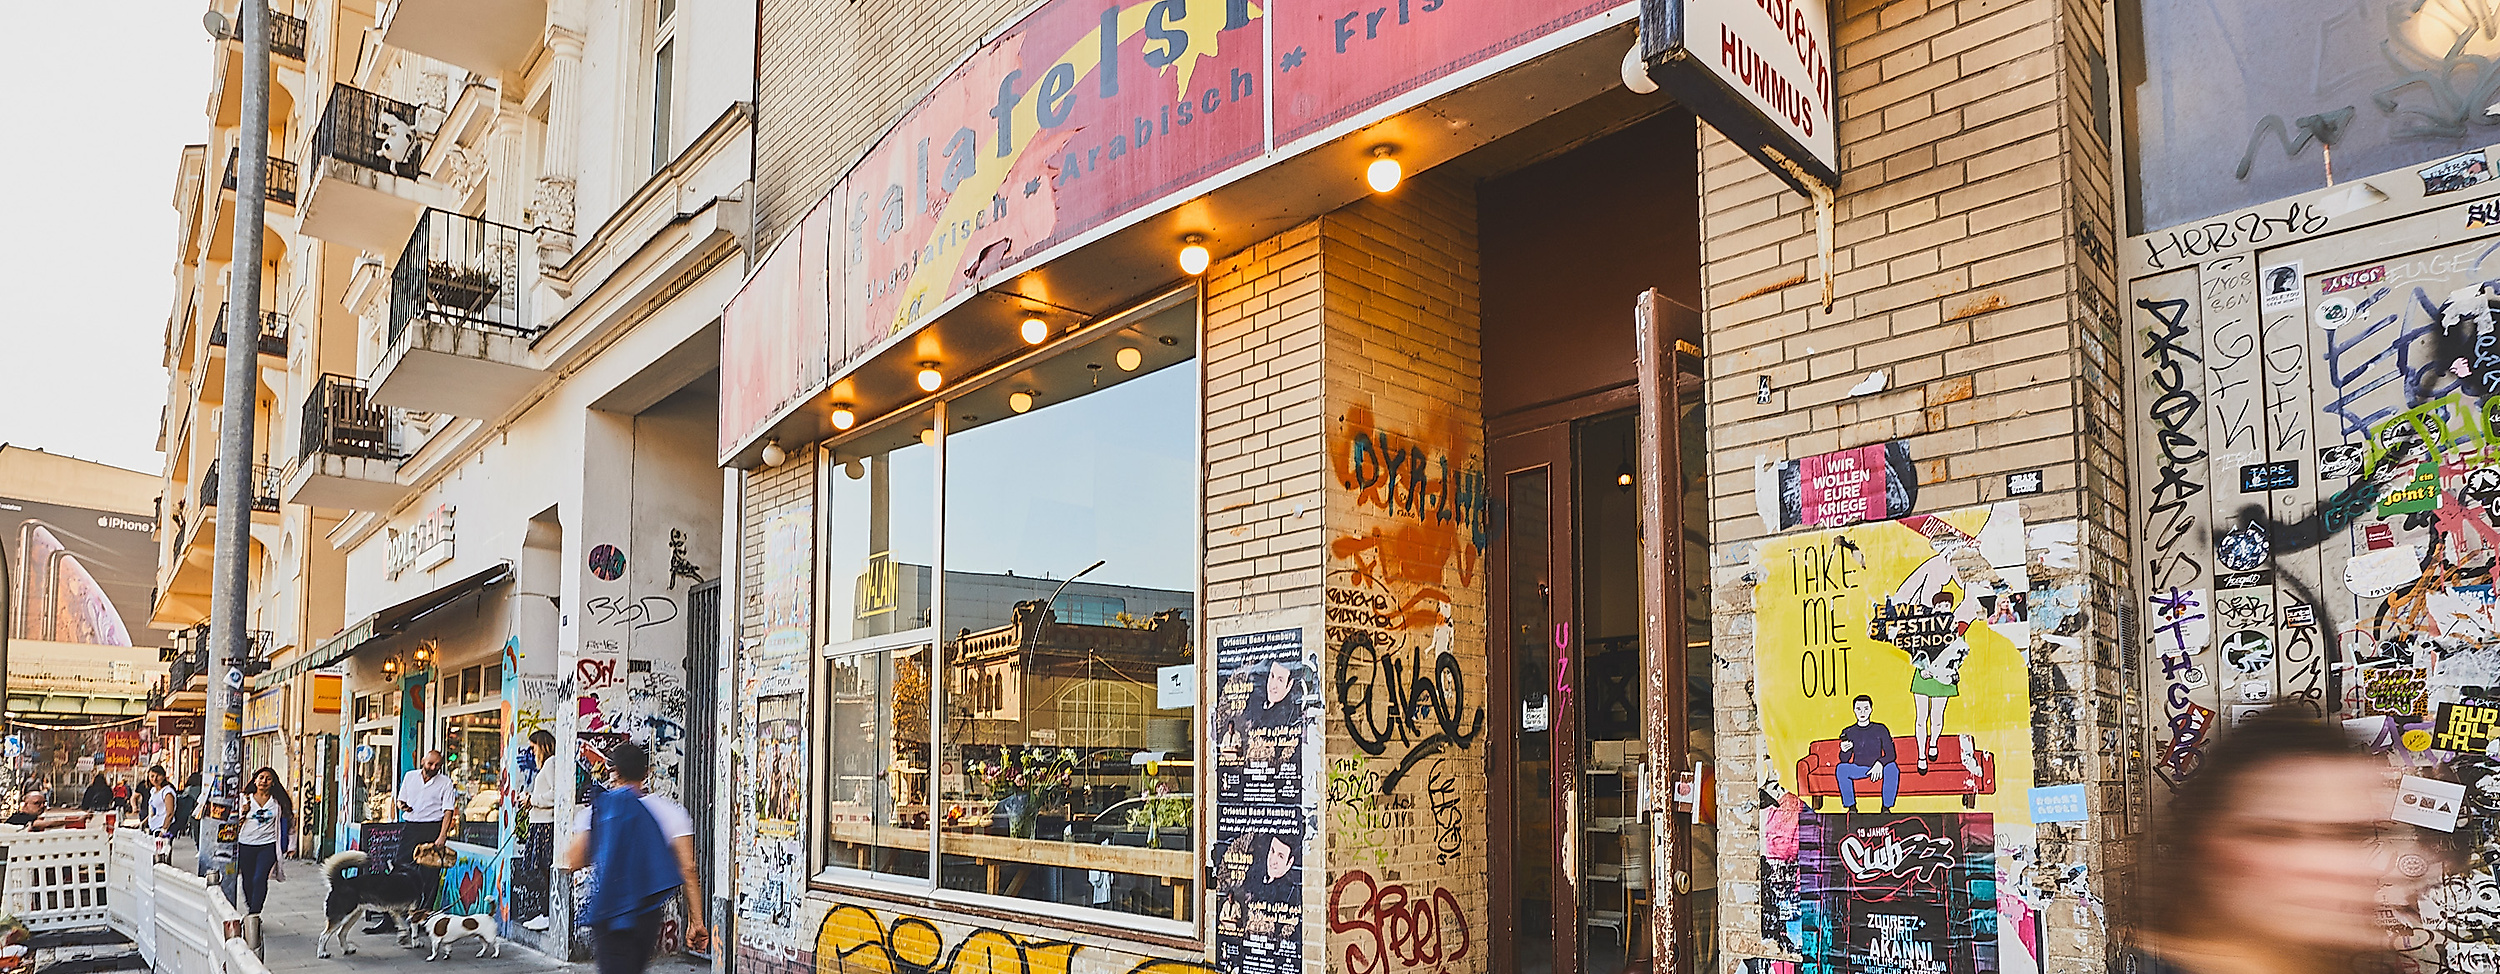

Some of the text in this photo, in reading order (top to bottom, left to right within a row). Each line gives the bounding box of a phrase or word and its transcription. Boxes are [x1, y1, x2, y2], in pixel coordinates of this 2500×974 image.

[1720, 22, 1814, 138] HUMMUS
[1058, 67, 1254, 187] Arabisch
[1827, 458, 1855, 474] WIR
[1813, 468, 1871, 490] WOLLEN
[1824, 484, 1861, 502] EURE
[1818, 498, 1868, 517] KRIEGE
[109, 517, 150, 533] iPhone
[1788, 544, 1859, 596] TAKE
[861, 558, 899, 611] W-LAN
[1802, 594, 1848, 646] ME
[1801, 646, 1852, 698] OUT
[2450, 704, 2499, 724] AUD
[1335, 758, 1359, 772] THE
[1866, 827, 1890, 838] JAHRE
[1869, 938, 1933, 961] AKANNI
